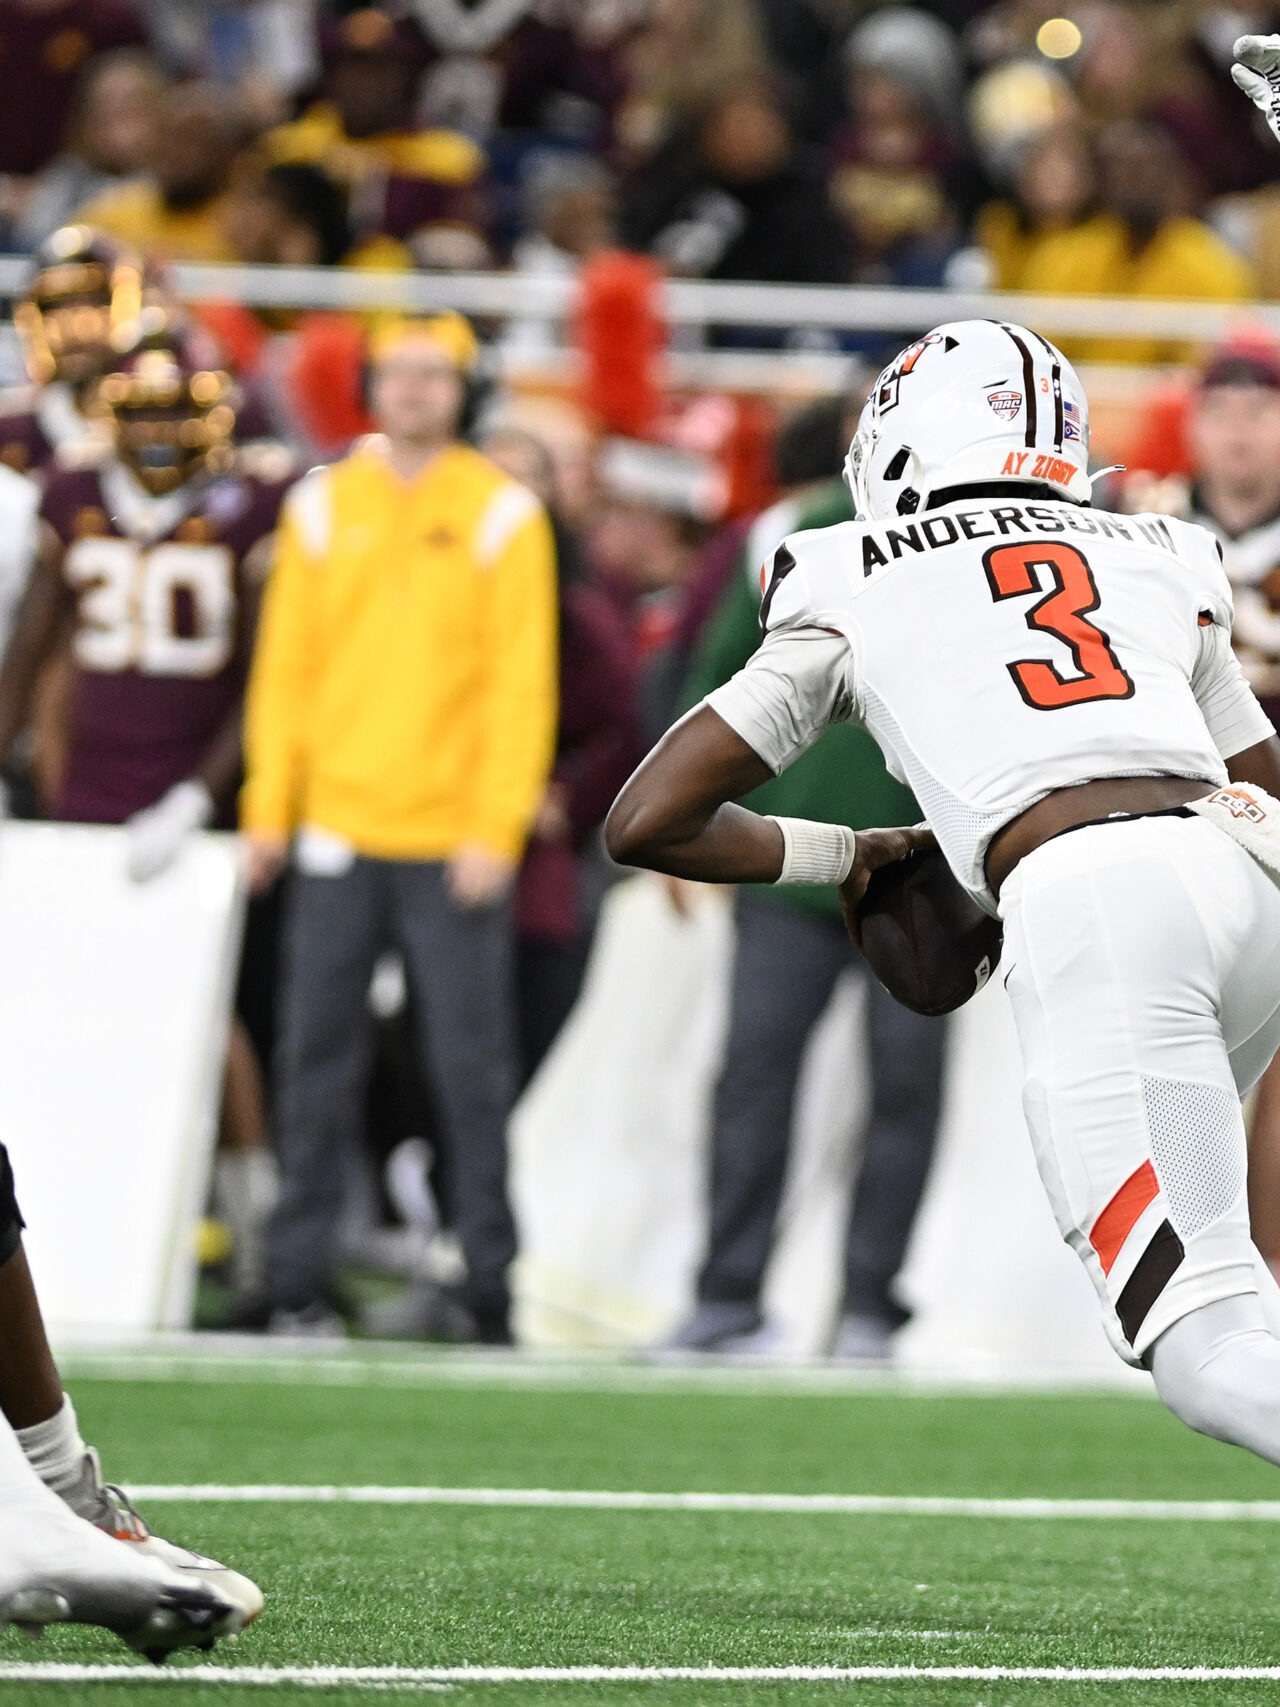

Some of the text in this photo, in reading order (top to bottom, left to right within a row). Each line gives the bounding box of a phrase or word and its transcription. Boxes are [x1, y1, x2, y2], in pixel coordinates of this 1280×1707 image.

[1040, 377, 1049, 393] 3
[1000, 451, 1079, 486] AY ZIGGY
[862, 506, 1134, 578] ANDERSON
[64, 536, 238, 681] 30
[981, 540, 1136, 711] 3
